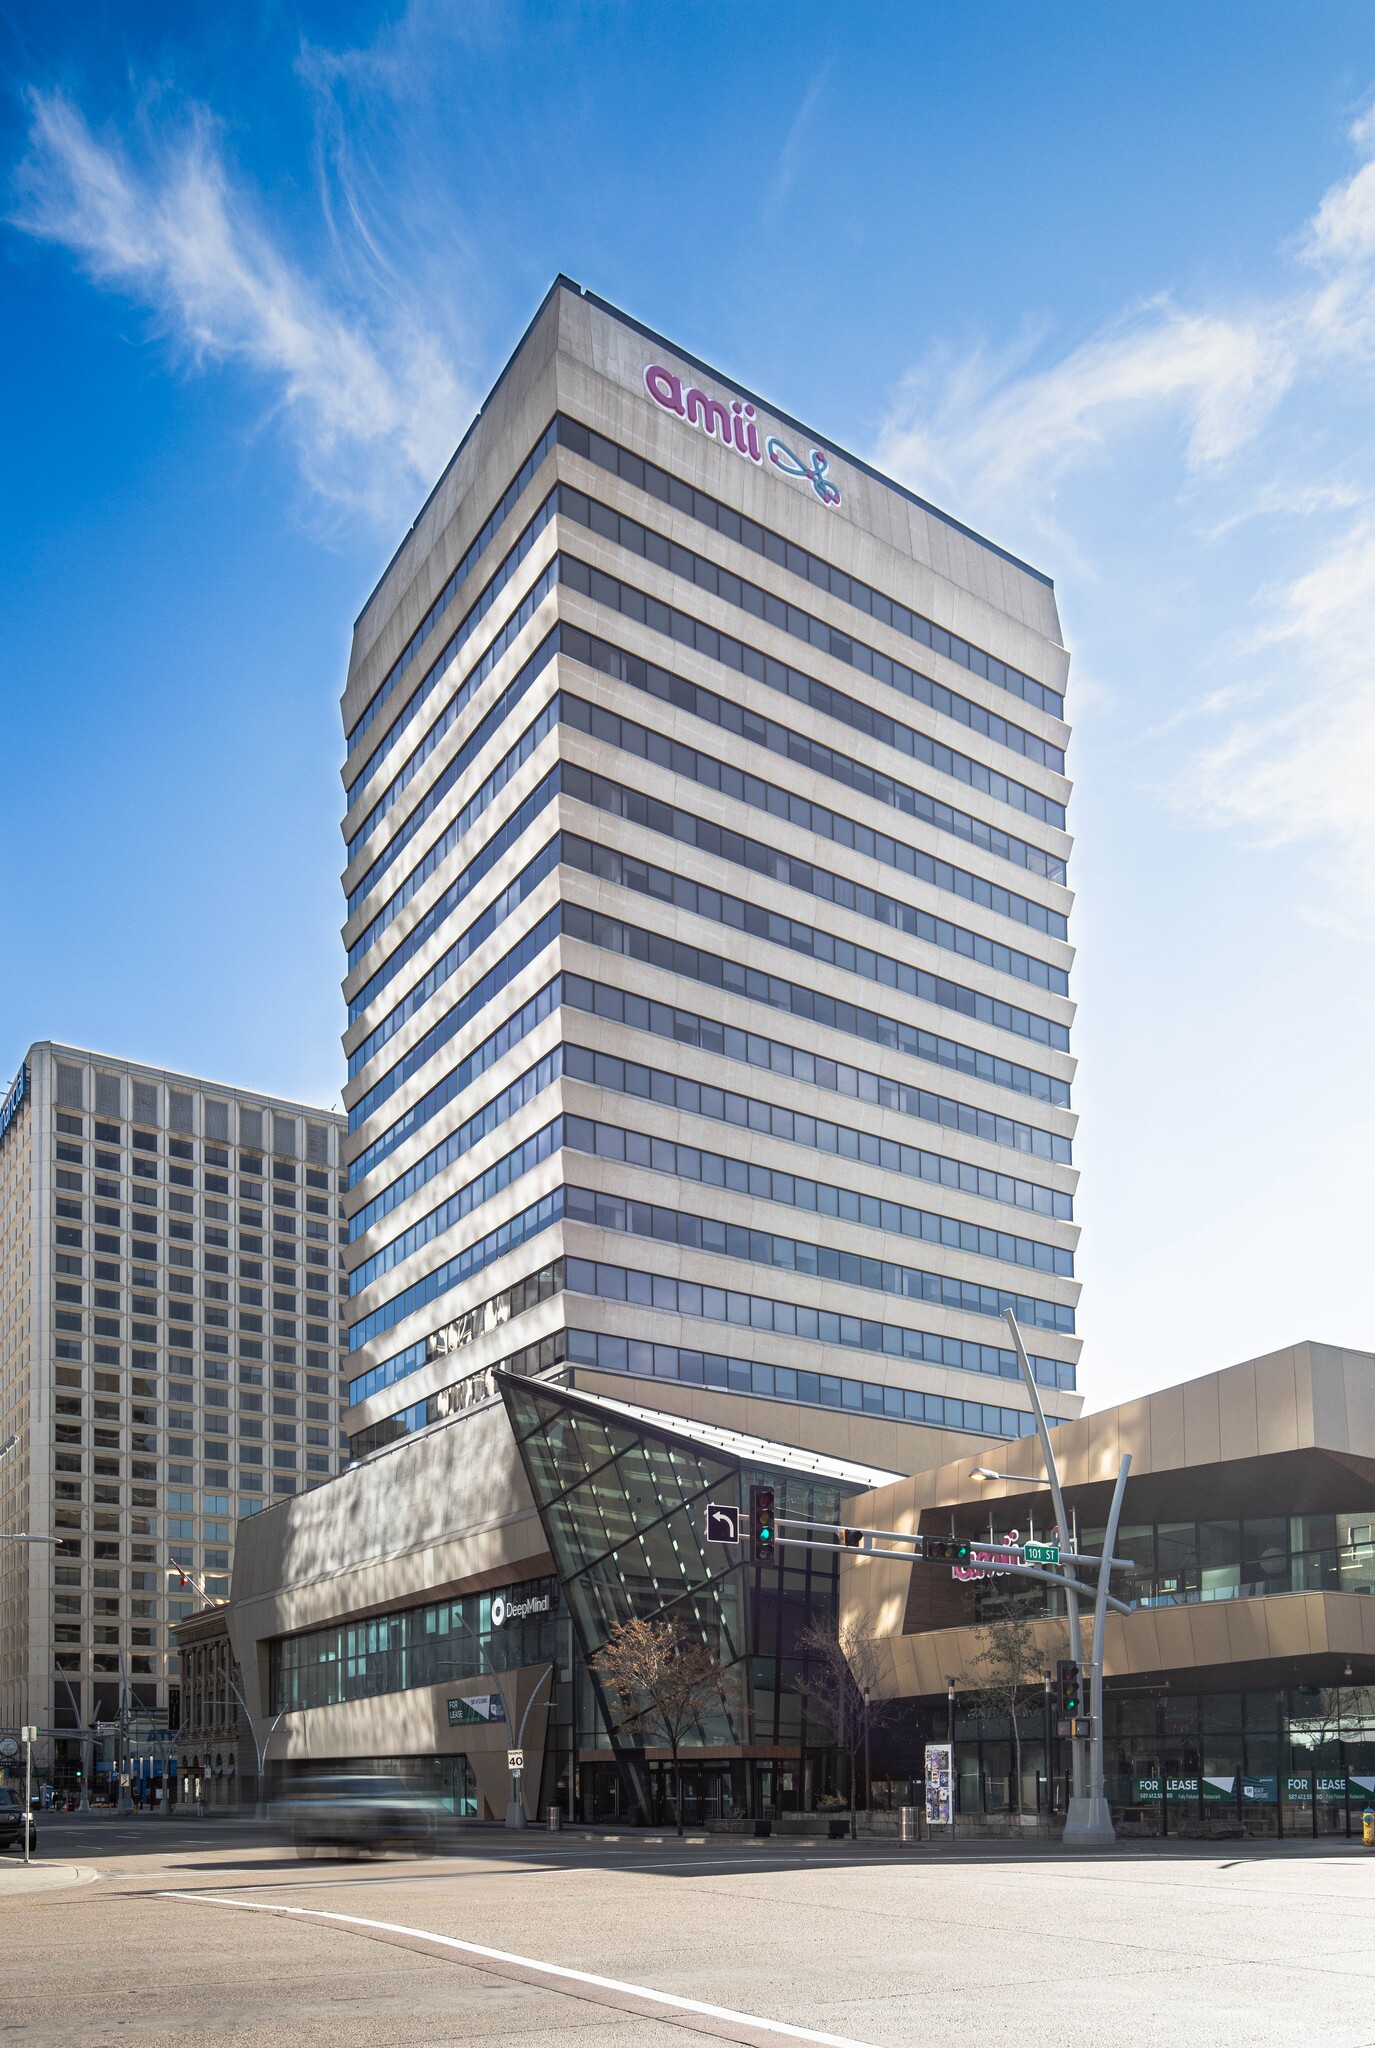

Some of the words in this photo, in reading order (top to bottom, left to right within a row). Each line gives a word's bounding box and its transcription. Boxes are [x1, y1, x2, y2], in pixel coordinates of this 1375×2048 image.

[644, 365, 762, 464] amii
[1028, 1549, 1041, 1559] 101
[1045, 1549, 1055, 1560] ST
[506, 1595, 550, 1618] DeepMind
[449, 1700, 458, 1709] FOR
[449, 1710, 463, 1719] LEASE
[509, 1757, 523, 1766] 40
[1139, 1780, 1159, 1790] FOR
[1166, 1780, 1198, 1790] LEASE
[1287, 1779, 1308, 1790] FOR
[1316, 1779, 1346, 1790] LEASE
